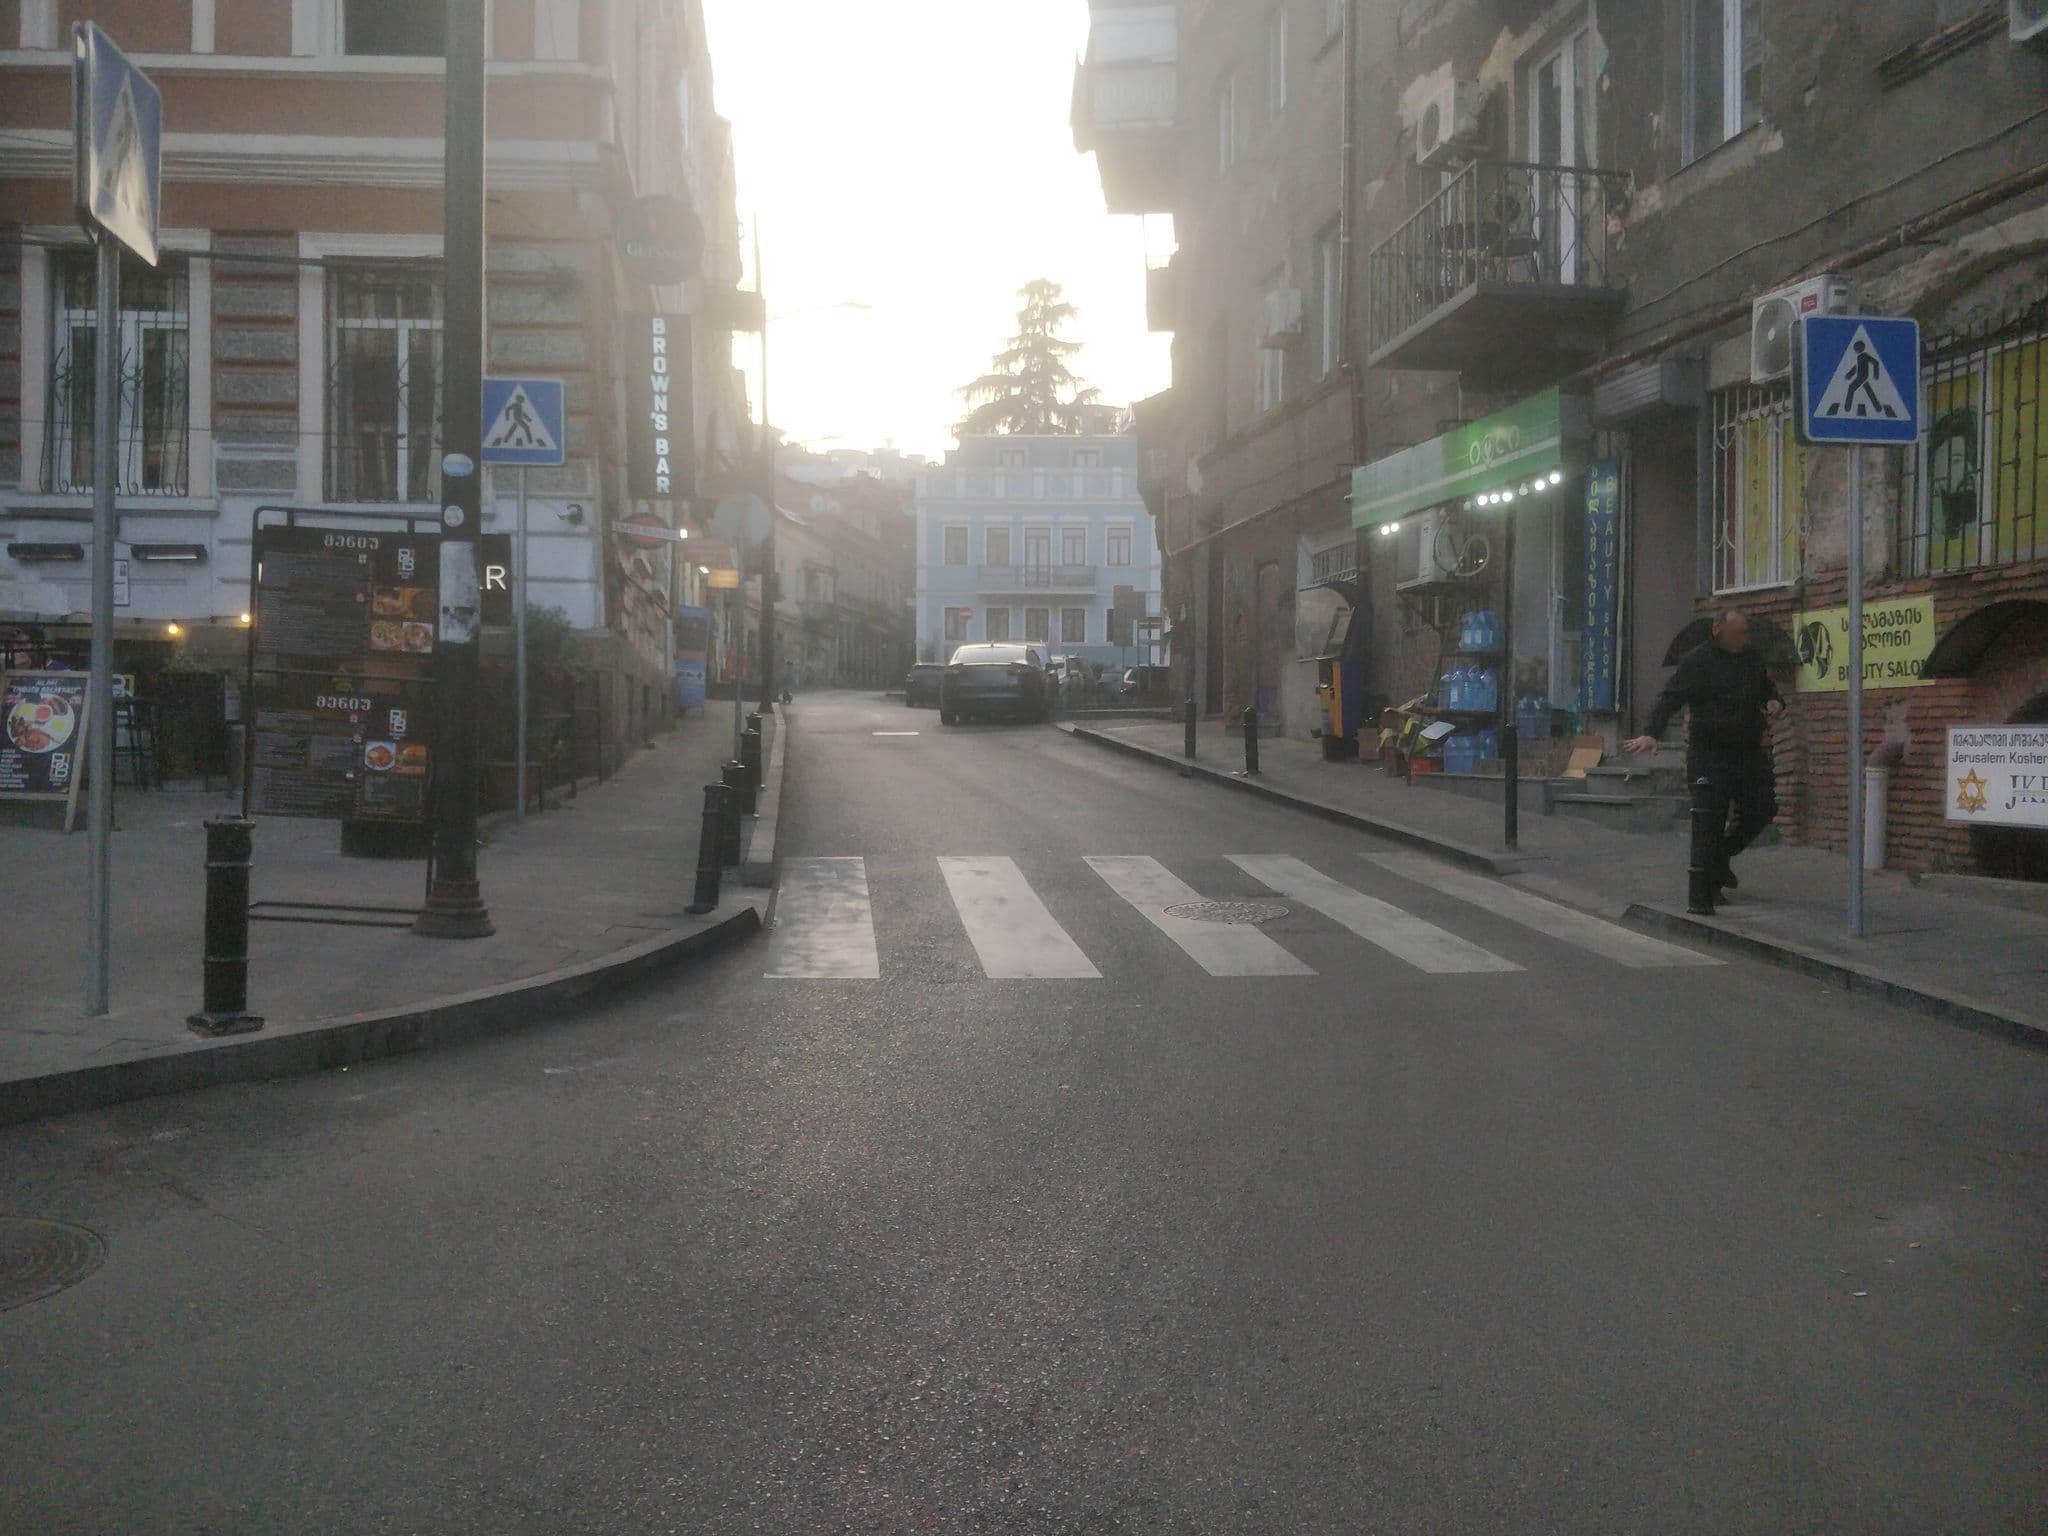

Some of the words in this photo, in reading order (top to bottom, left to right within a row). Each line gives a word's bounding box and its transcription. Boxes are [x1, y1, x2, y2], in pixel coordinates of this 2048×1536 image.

[650, 317, 670, 432] BROWN'S
[655, 437, 671, 494] BAR
[1603, 476, 1614, 602] BEAUTY
[1602, 612, 1610, 680] SALON
[1841, 608, 1922, 632] სლამაზის
[1838, 662, 1884, 681] BUTY
[1887, 659, 1924, 678] SALO
[1952, 751, 2006, 764] Jerusalem
[2009, 751, 2048, 765] Kosher
